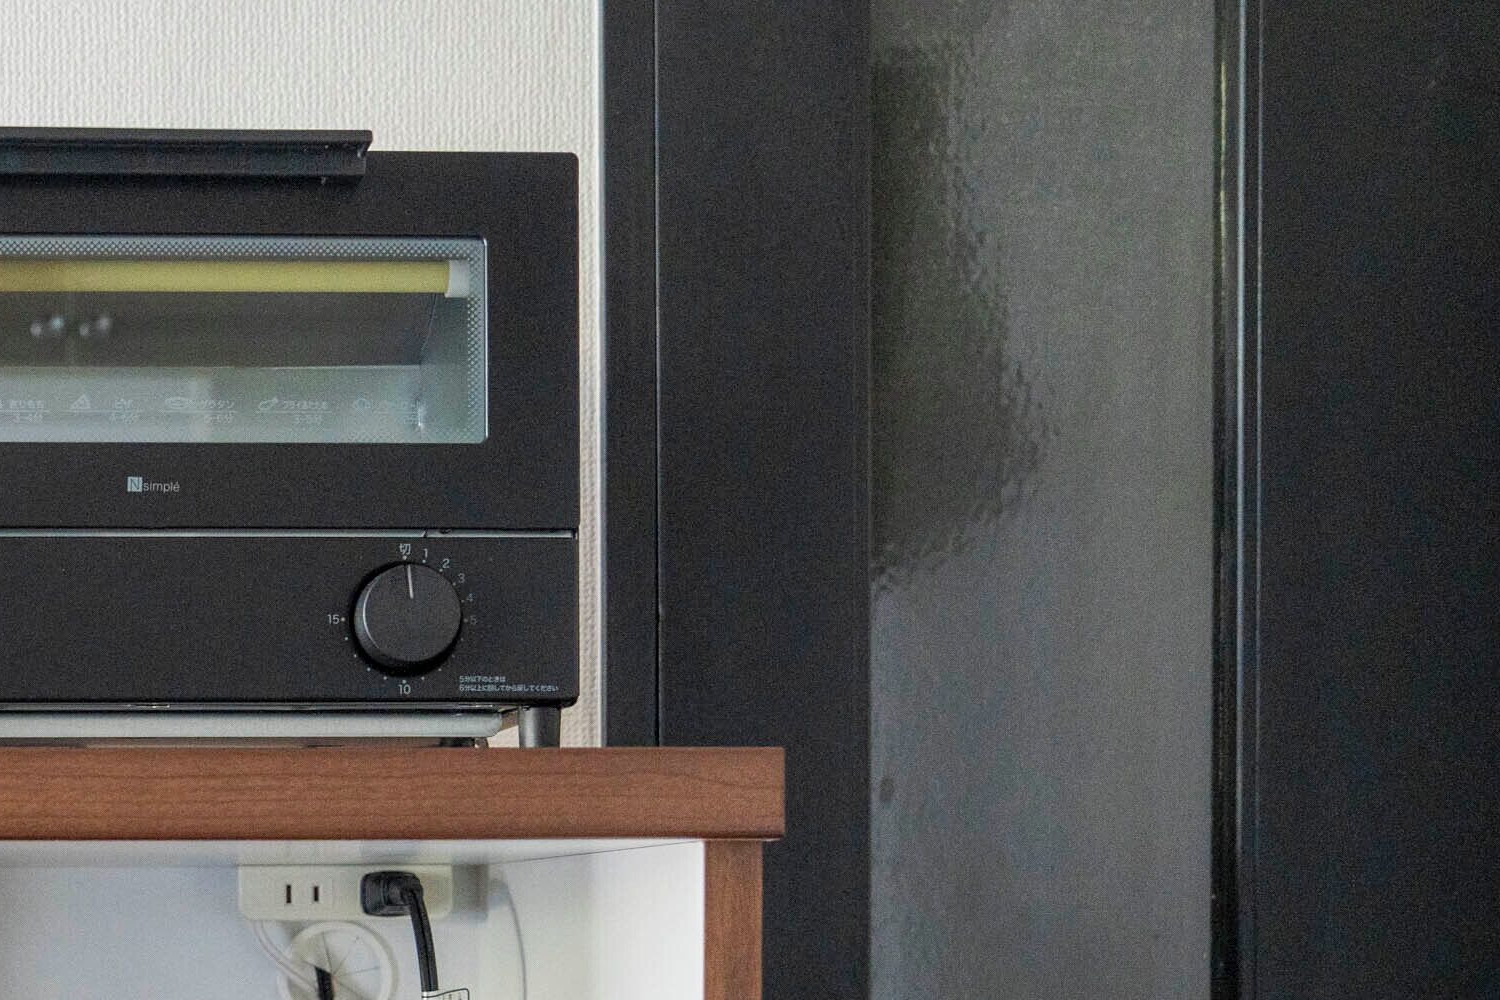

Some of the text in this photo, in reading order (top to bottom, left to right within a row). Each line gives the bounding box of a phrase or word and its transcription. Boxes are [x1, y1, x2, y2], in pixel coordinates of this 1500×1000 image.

[399, 543, 411, 555] 切
[424, 548, 428, 558] 1
[442, 558, 450, 569] 2
[458, 573, 465, 583] 3
[466, 592, 475, 602] 4
[327, 614, 340, 625] 15
[469, 614, 477, 625] 5
[397, 684, 411, 695] 10
